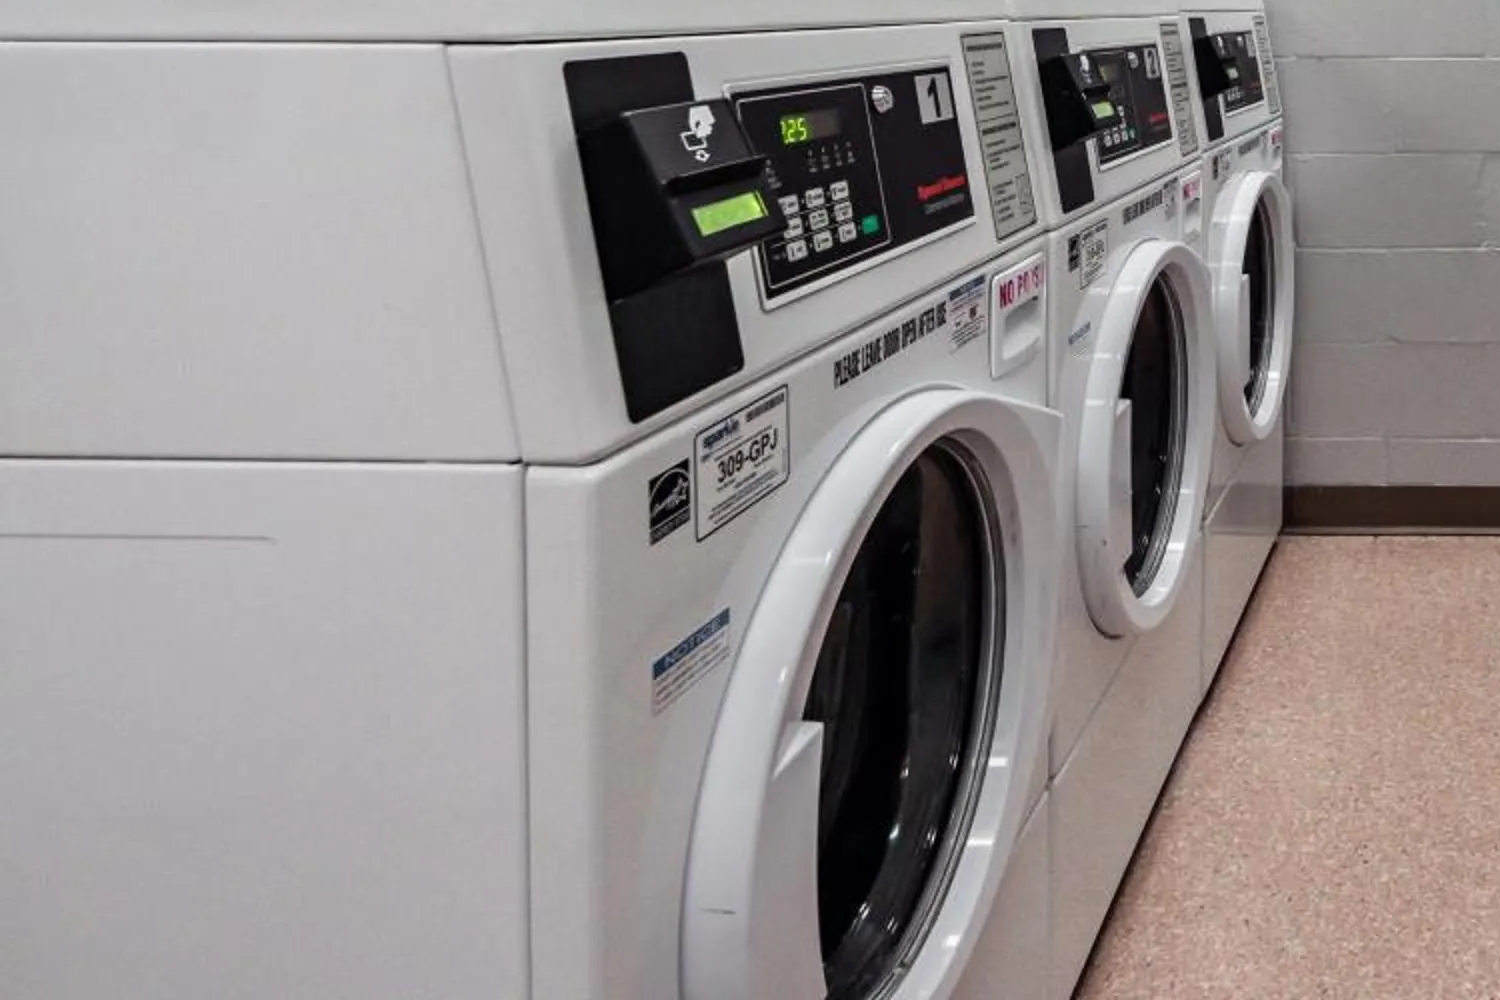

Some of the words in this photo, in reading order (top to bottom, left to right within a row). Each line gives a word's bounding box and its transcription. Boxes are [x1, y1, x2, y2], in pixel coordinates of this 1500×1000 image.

[927, 76, 942, 118] 1
[999, 279, 1015, 309] NO
[833, 349, 861, 389] PLEASE
[716, 427, 779, 483] 309-GPJ
